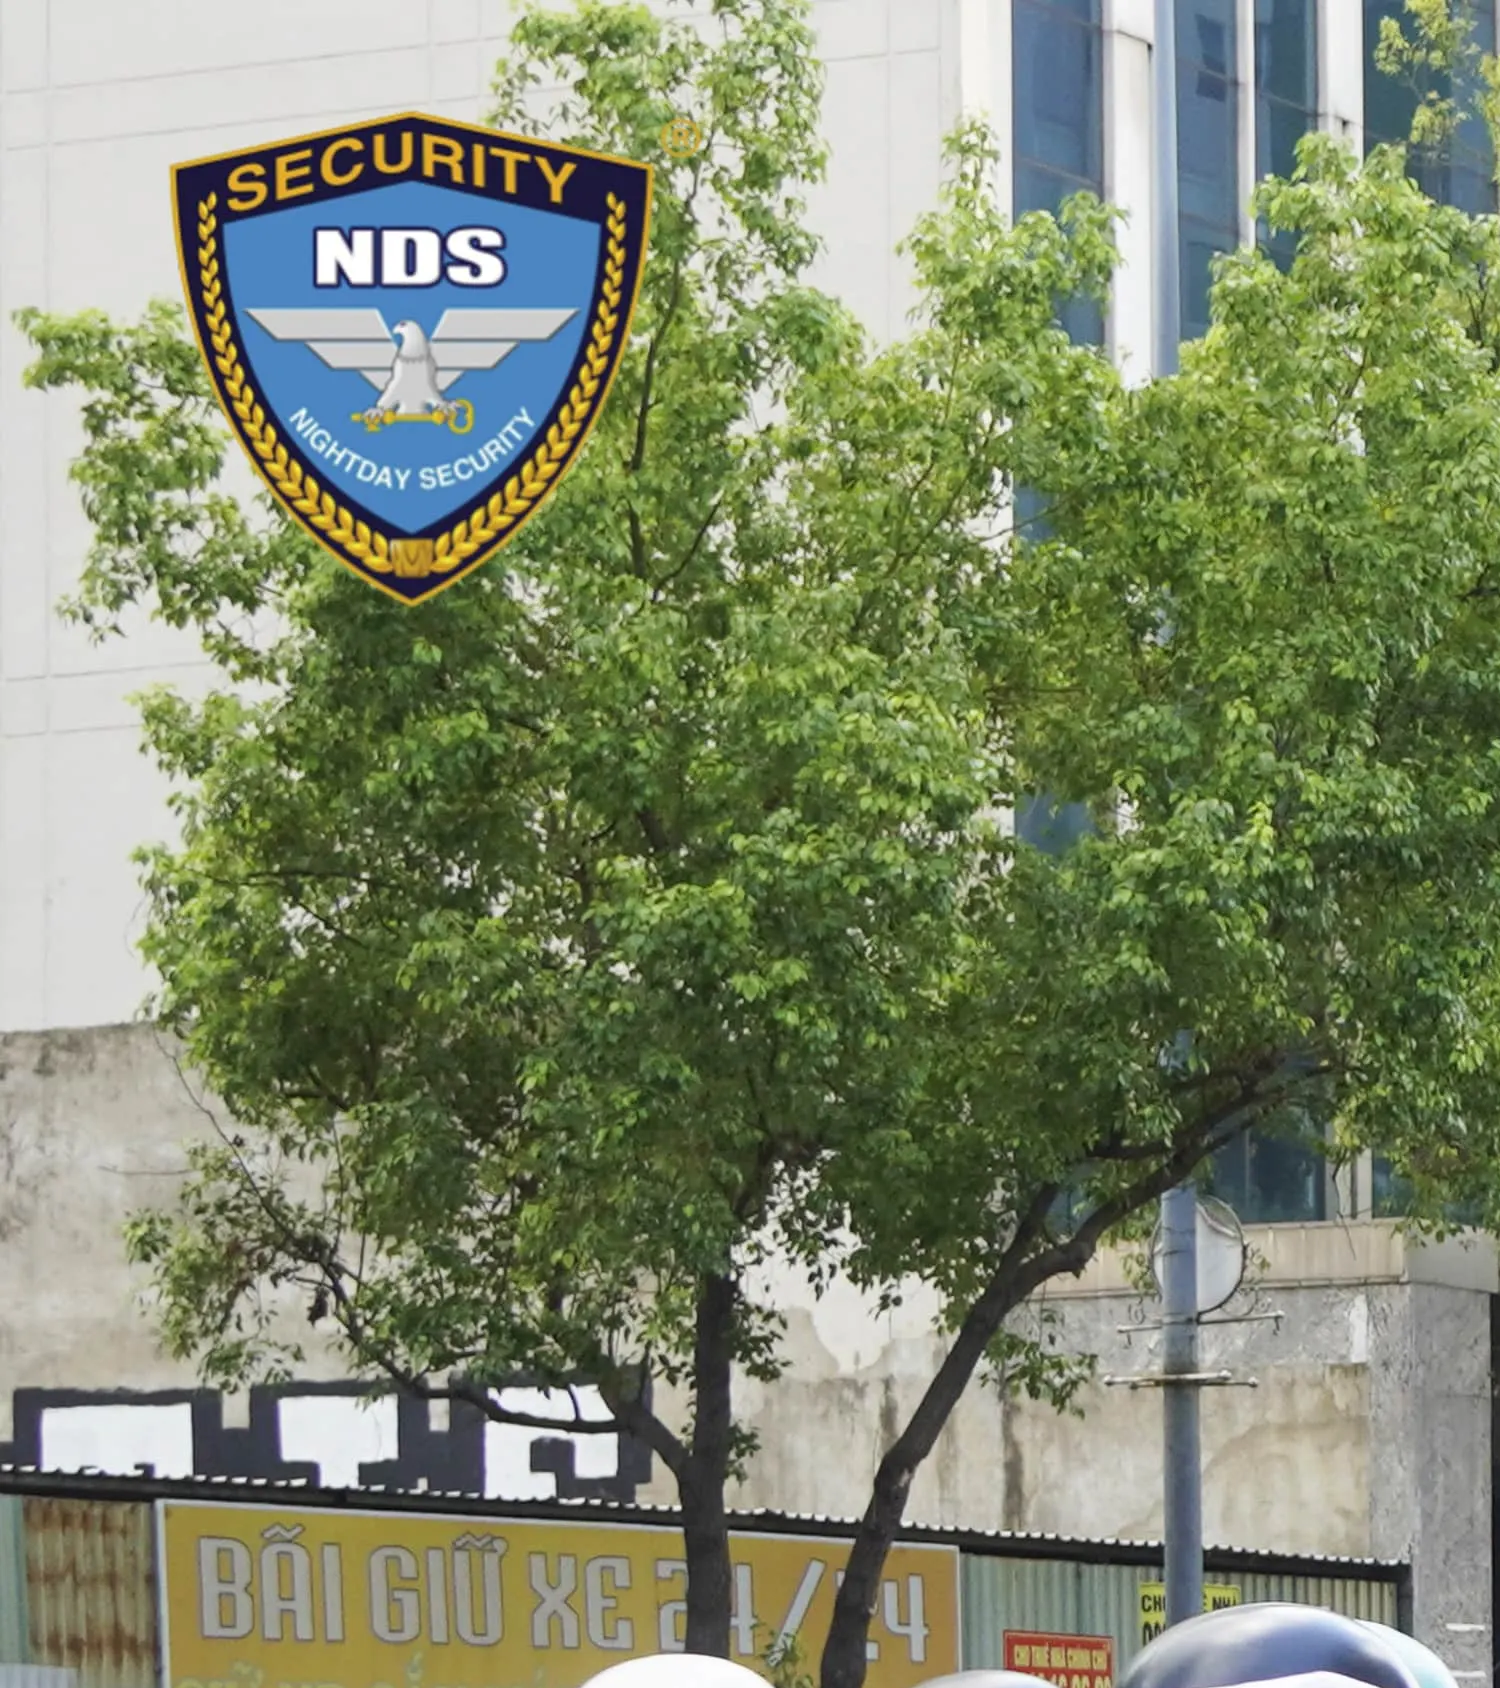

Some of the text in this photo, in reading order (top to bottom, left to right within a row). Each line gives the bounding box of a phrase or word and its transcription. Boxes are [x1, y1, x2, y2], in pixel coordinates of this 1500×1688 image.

[199, 1522, 346, 1644] BÃI
[367, 1532, 508, 1648] GIỮ
[529, 1552, 634, 1651] XE
